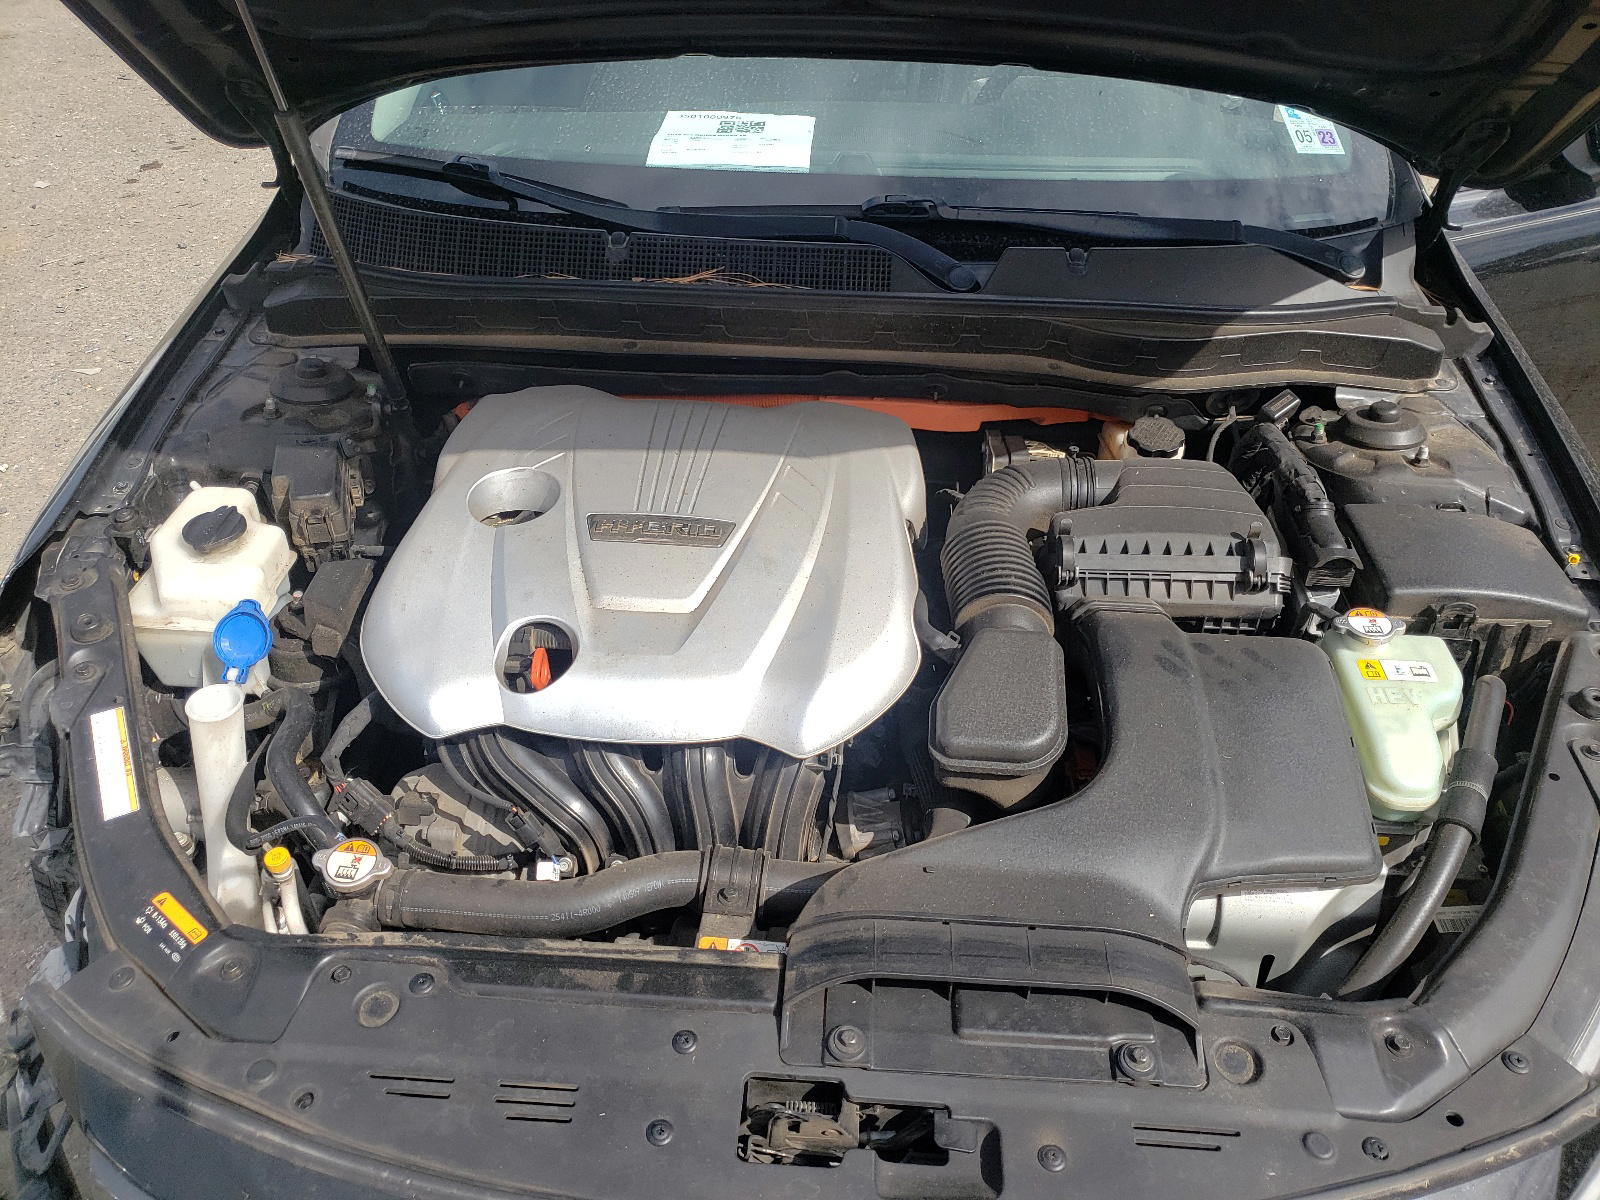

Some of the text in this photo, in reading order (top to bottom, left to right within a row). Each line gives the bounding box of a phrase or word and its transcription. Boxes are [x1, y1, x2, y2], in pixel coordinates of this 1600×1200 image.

[1295, 129, 1313, 143] 05
[1317, 130, 1336, 145] 23
[593, 519, 723, 539] HYBRID
